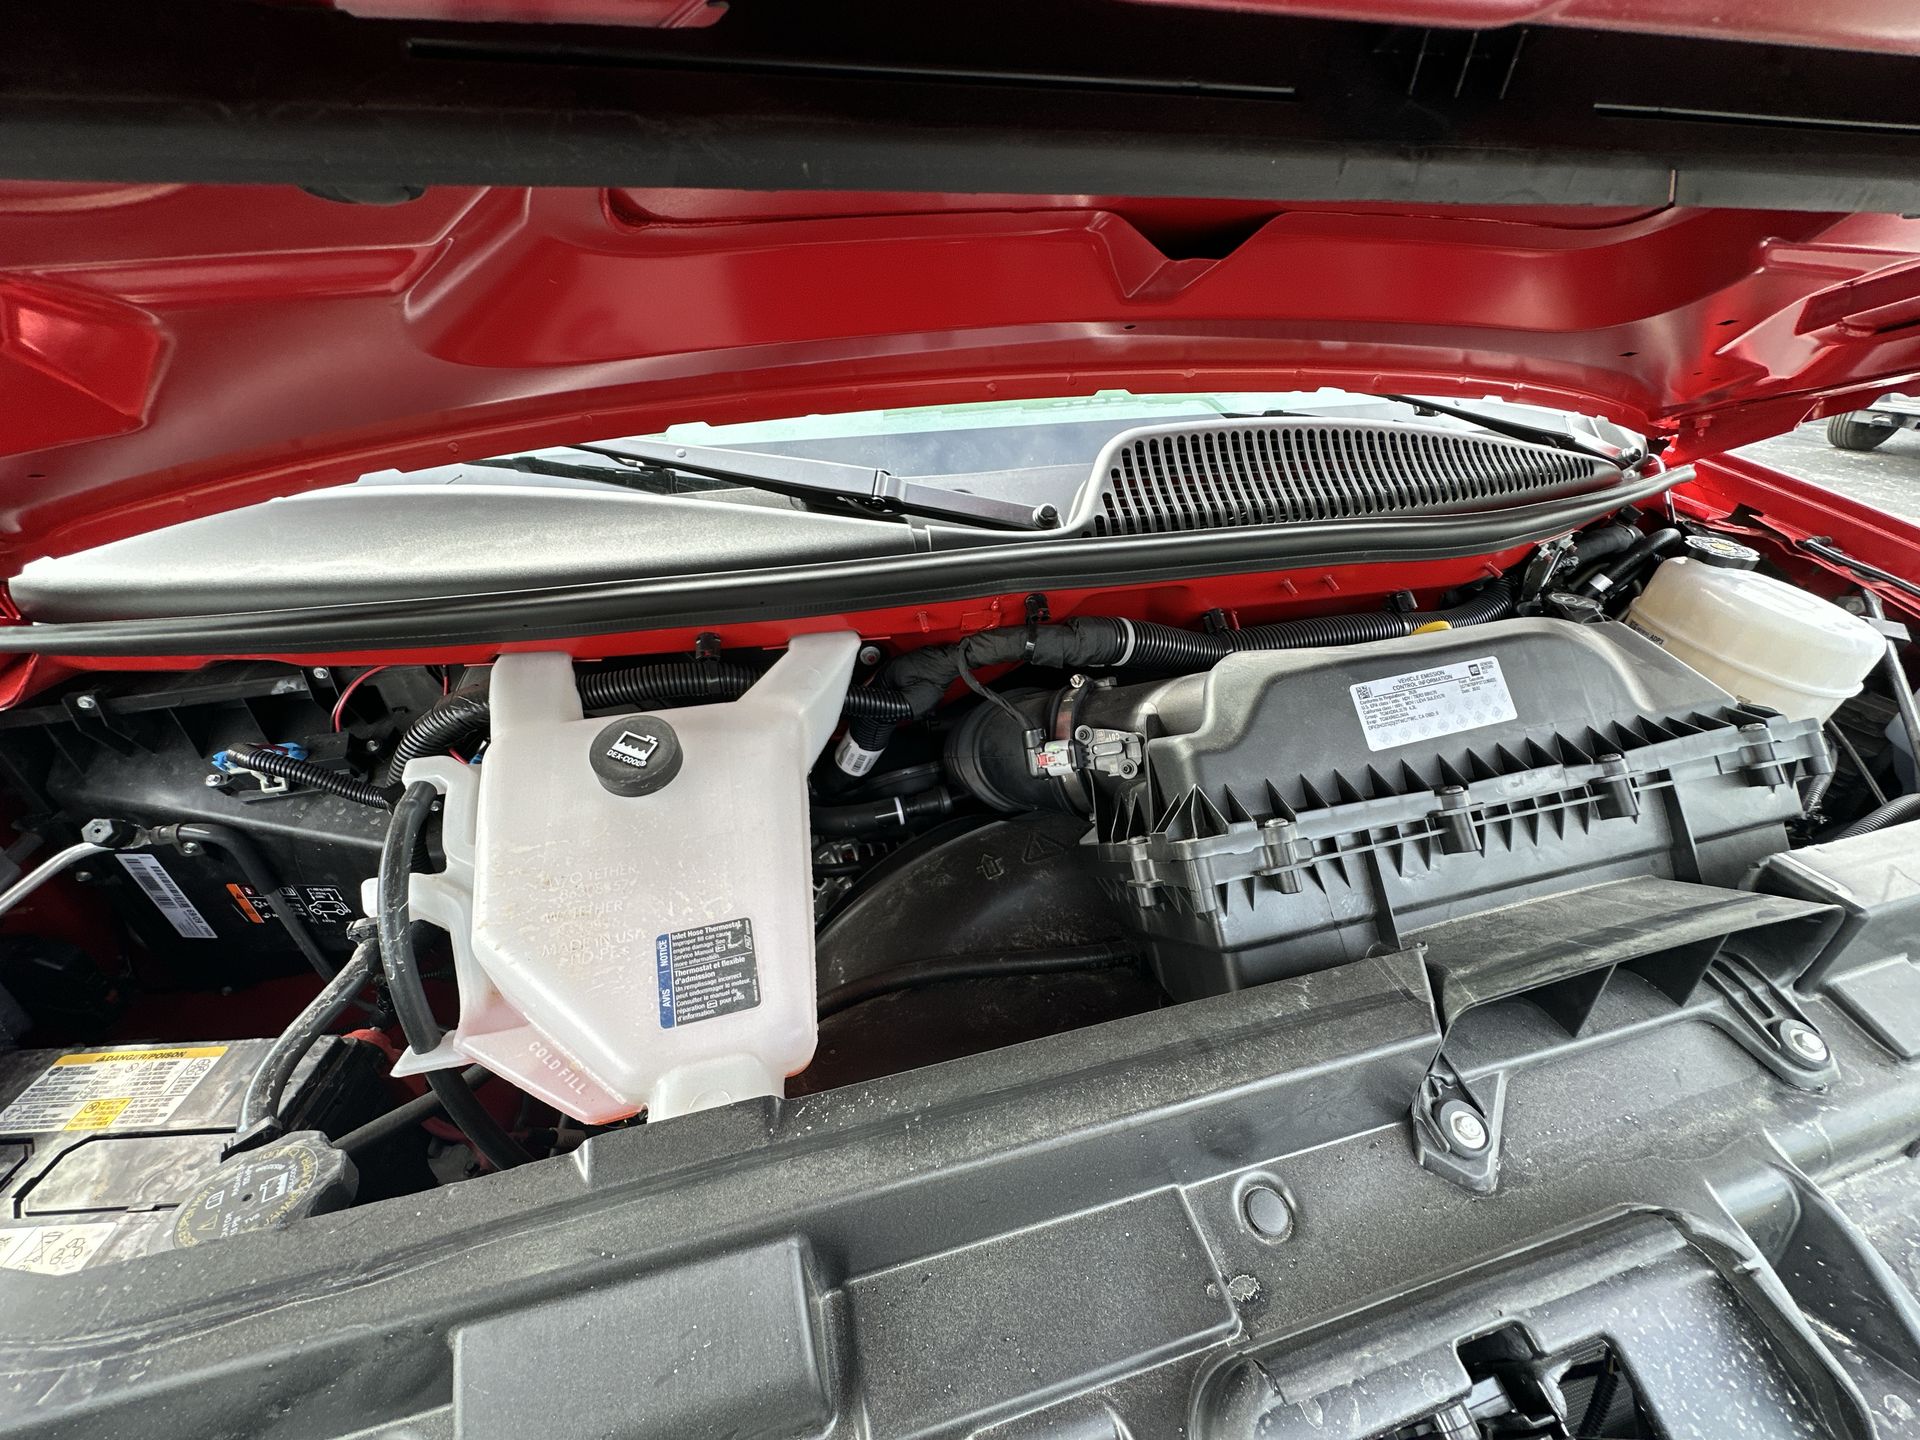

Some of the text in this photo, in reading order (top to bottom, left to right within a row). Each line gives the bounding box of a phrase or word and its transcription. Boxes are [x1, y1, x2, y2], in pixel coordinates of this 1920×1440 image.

[1392, 682, 1417, 690] CONTROL
[1417, 674, 1453, 685] INFORMATION
[1397, 670, 1445, 683] VEHICLE EMISSION
[688, 929, 703, 937] Hose
[660, 940, 668, 967] NOTICE
[675, 963, 711, 977] Thermostat
[721, 956, 745, 966] flexible
[675, 970, 715, 985] d'admission
[662, 988, 671, 1007] AVIS
[529, 1041, 586, 1095] COLD FILL
